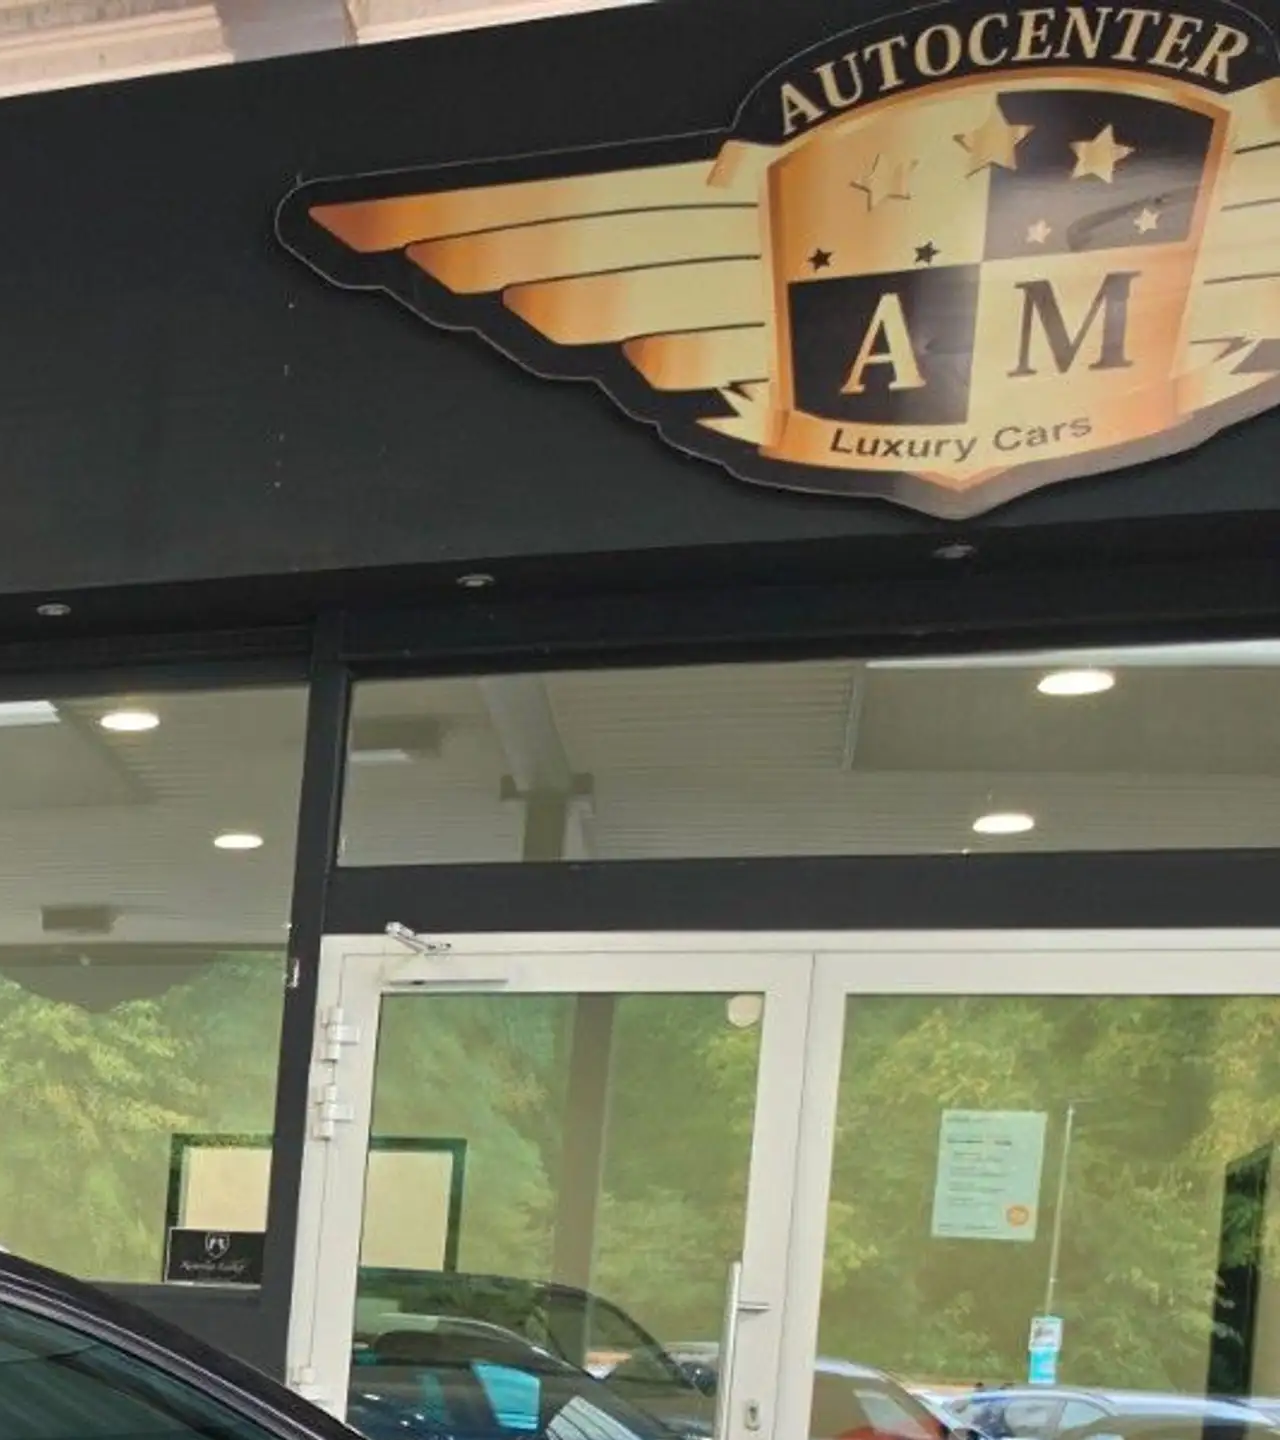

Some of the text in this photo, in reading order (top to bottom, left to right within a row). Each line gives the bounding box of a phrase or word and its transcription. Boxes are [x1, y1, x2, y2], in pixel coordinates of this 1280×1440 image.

[781, 5, 1250, 135] AUTOCENTER
[840, 270, 1143, 395] A M
[829, 416, 1093, 464] Luxury Cars
